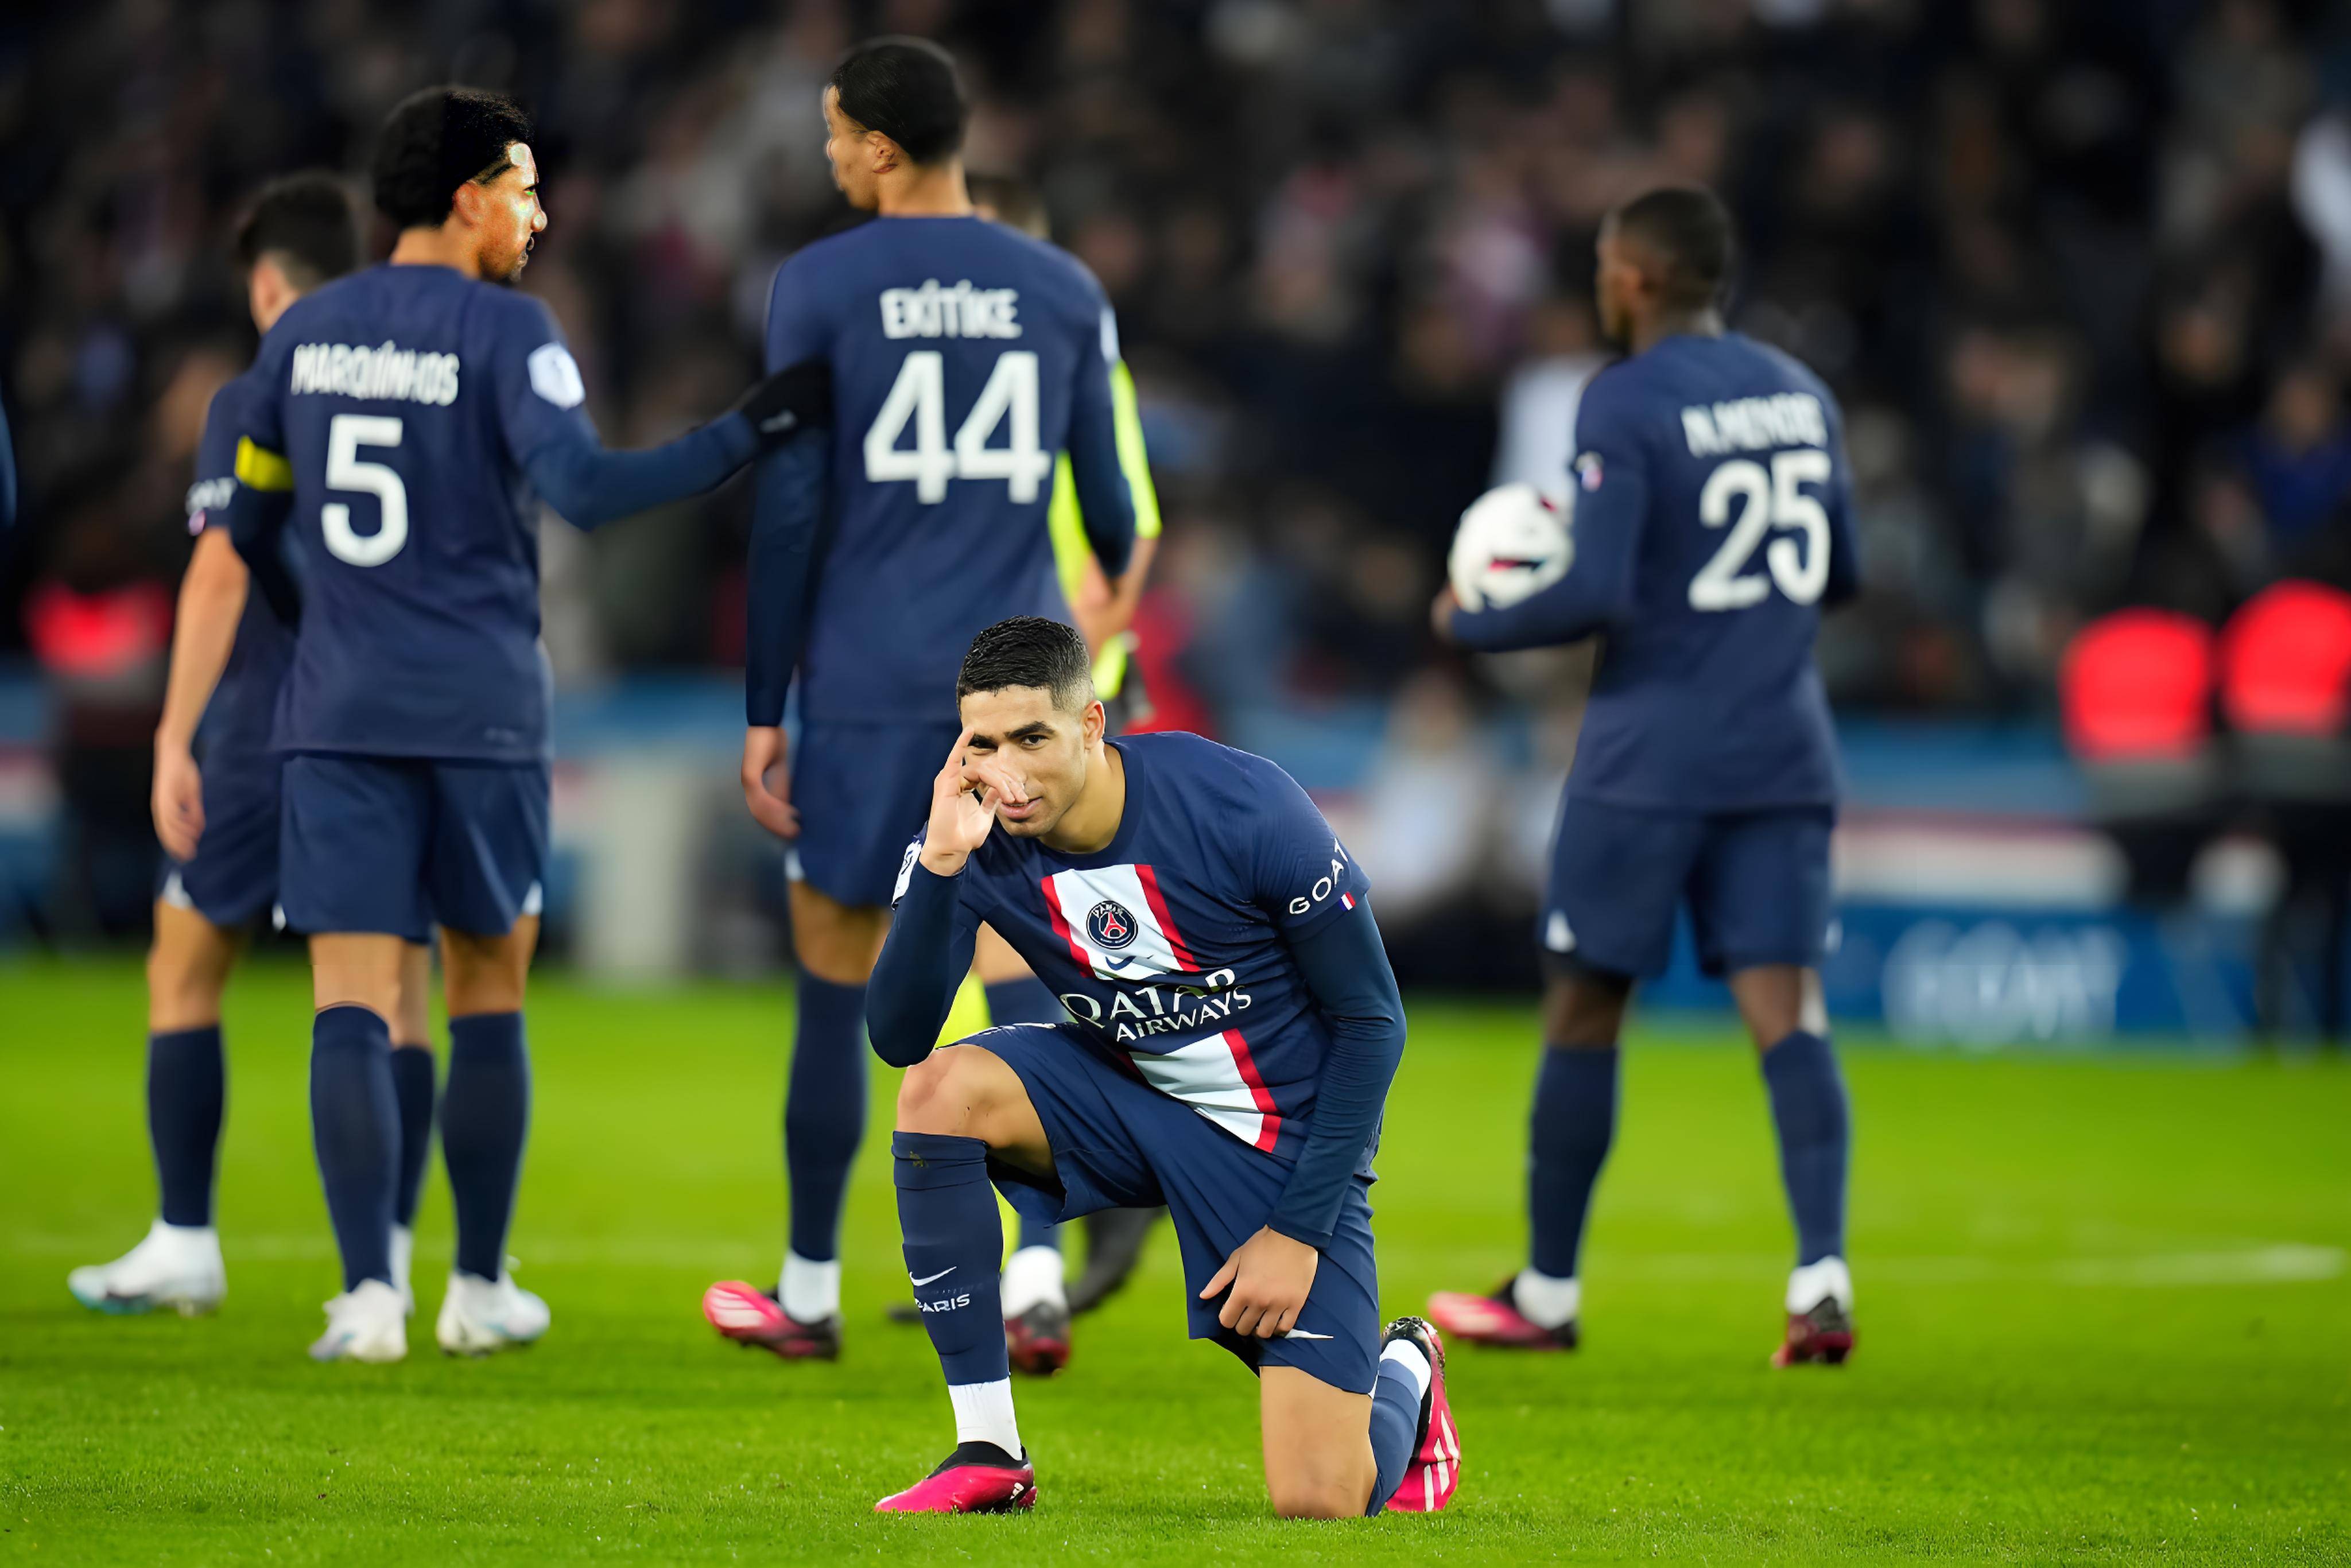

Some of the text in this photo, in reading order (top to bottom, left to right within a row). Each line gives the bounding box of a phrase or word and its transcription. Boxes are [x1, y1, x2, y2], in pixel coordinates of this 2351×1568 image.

[863, 350, 1052, 504] 44
[321, 414, 408, 567] 5
[1688, 449, 1832, 612] 25
[1289, 837, 1348, 914] GOAT
[1116, 985, 1251, 1042] AIRWAYS
[914, 1293, 970, 1313] PARIS
